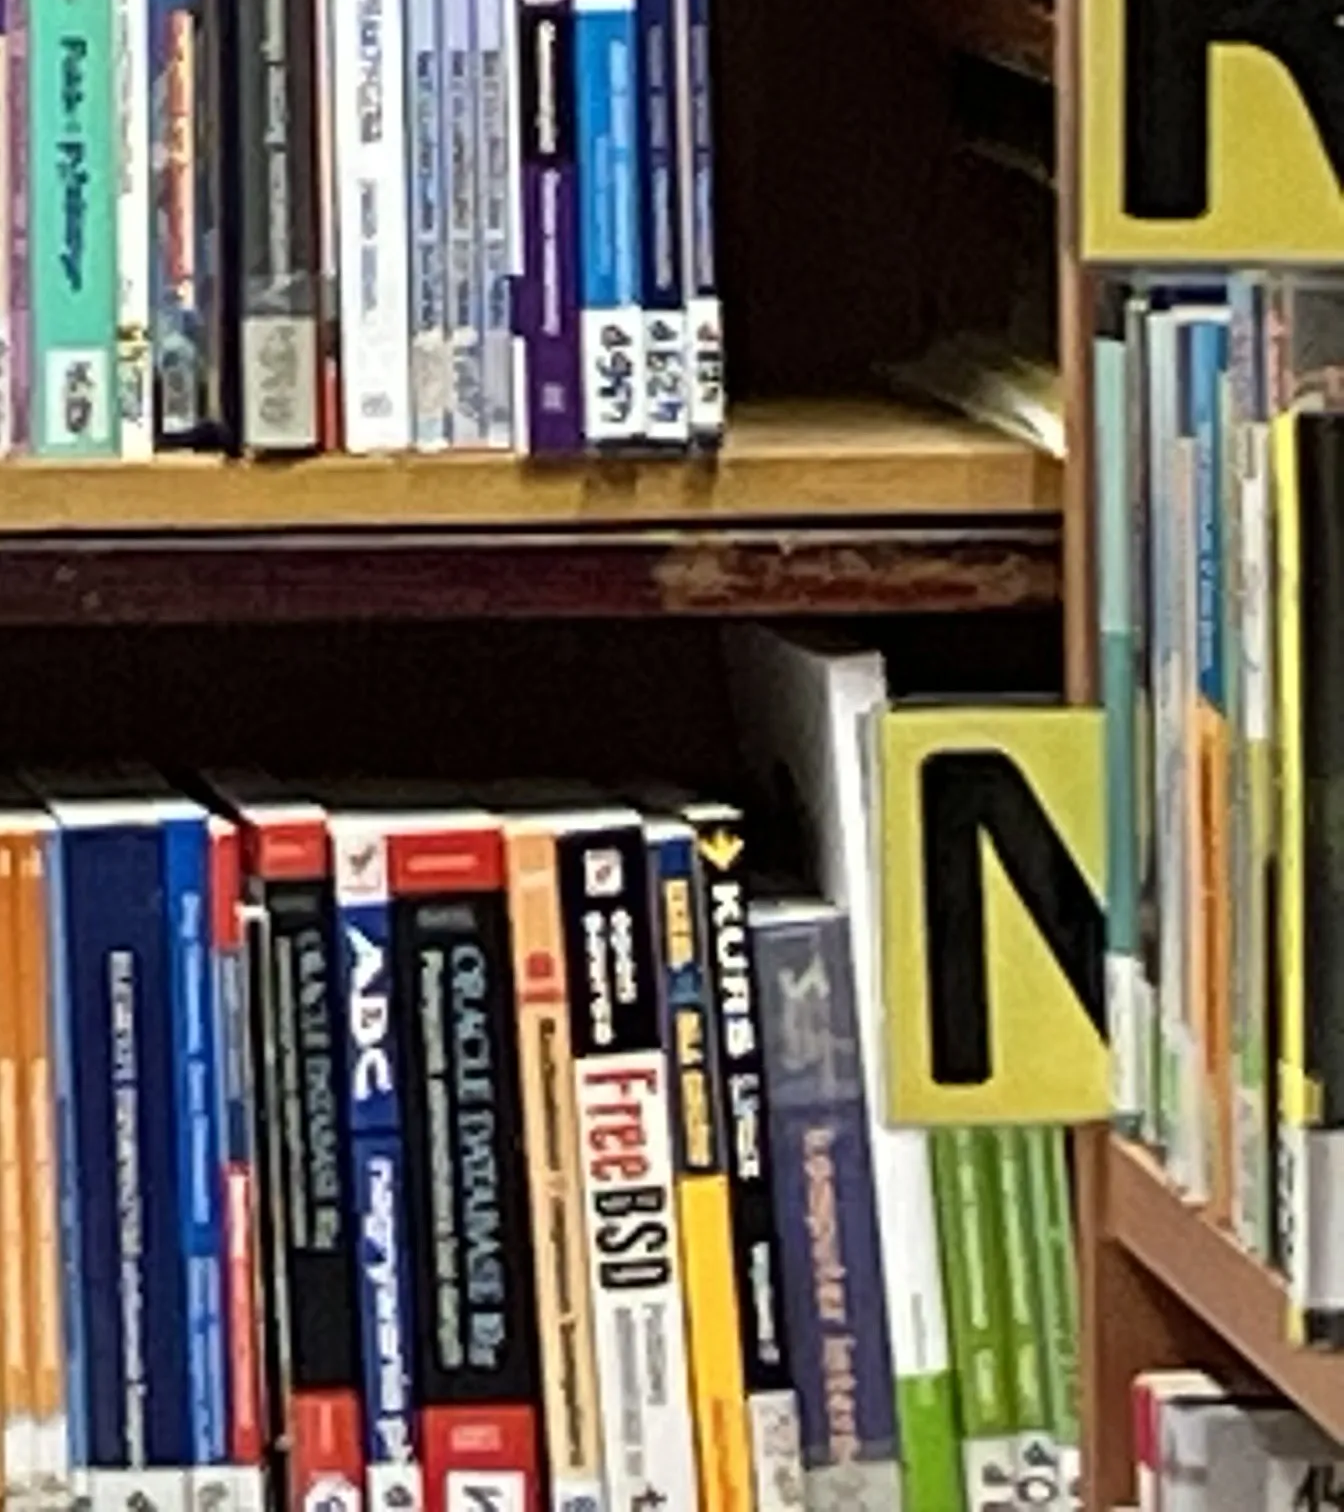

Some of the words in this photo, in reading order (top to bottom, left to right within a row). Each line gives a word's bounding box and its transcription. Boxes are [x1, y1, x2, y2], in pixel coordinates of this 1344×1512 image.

[711, 882, 754, 1058] KURS
[920, 747, 1109, 1086] N
[347, 927, 394, 1101] ABC
[451, 945, 488, 1099] ORACLE
[457, 1109, 506, 1301] DATABASE
[586, 1068, 672, 1291] FreeBSD
[361, 1157, 405, 1411] nagrywania
